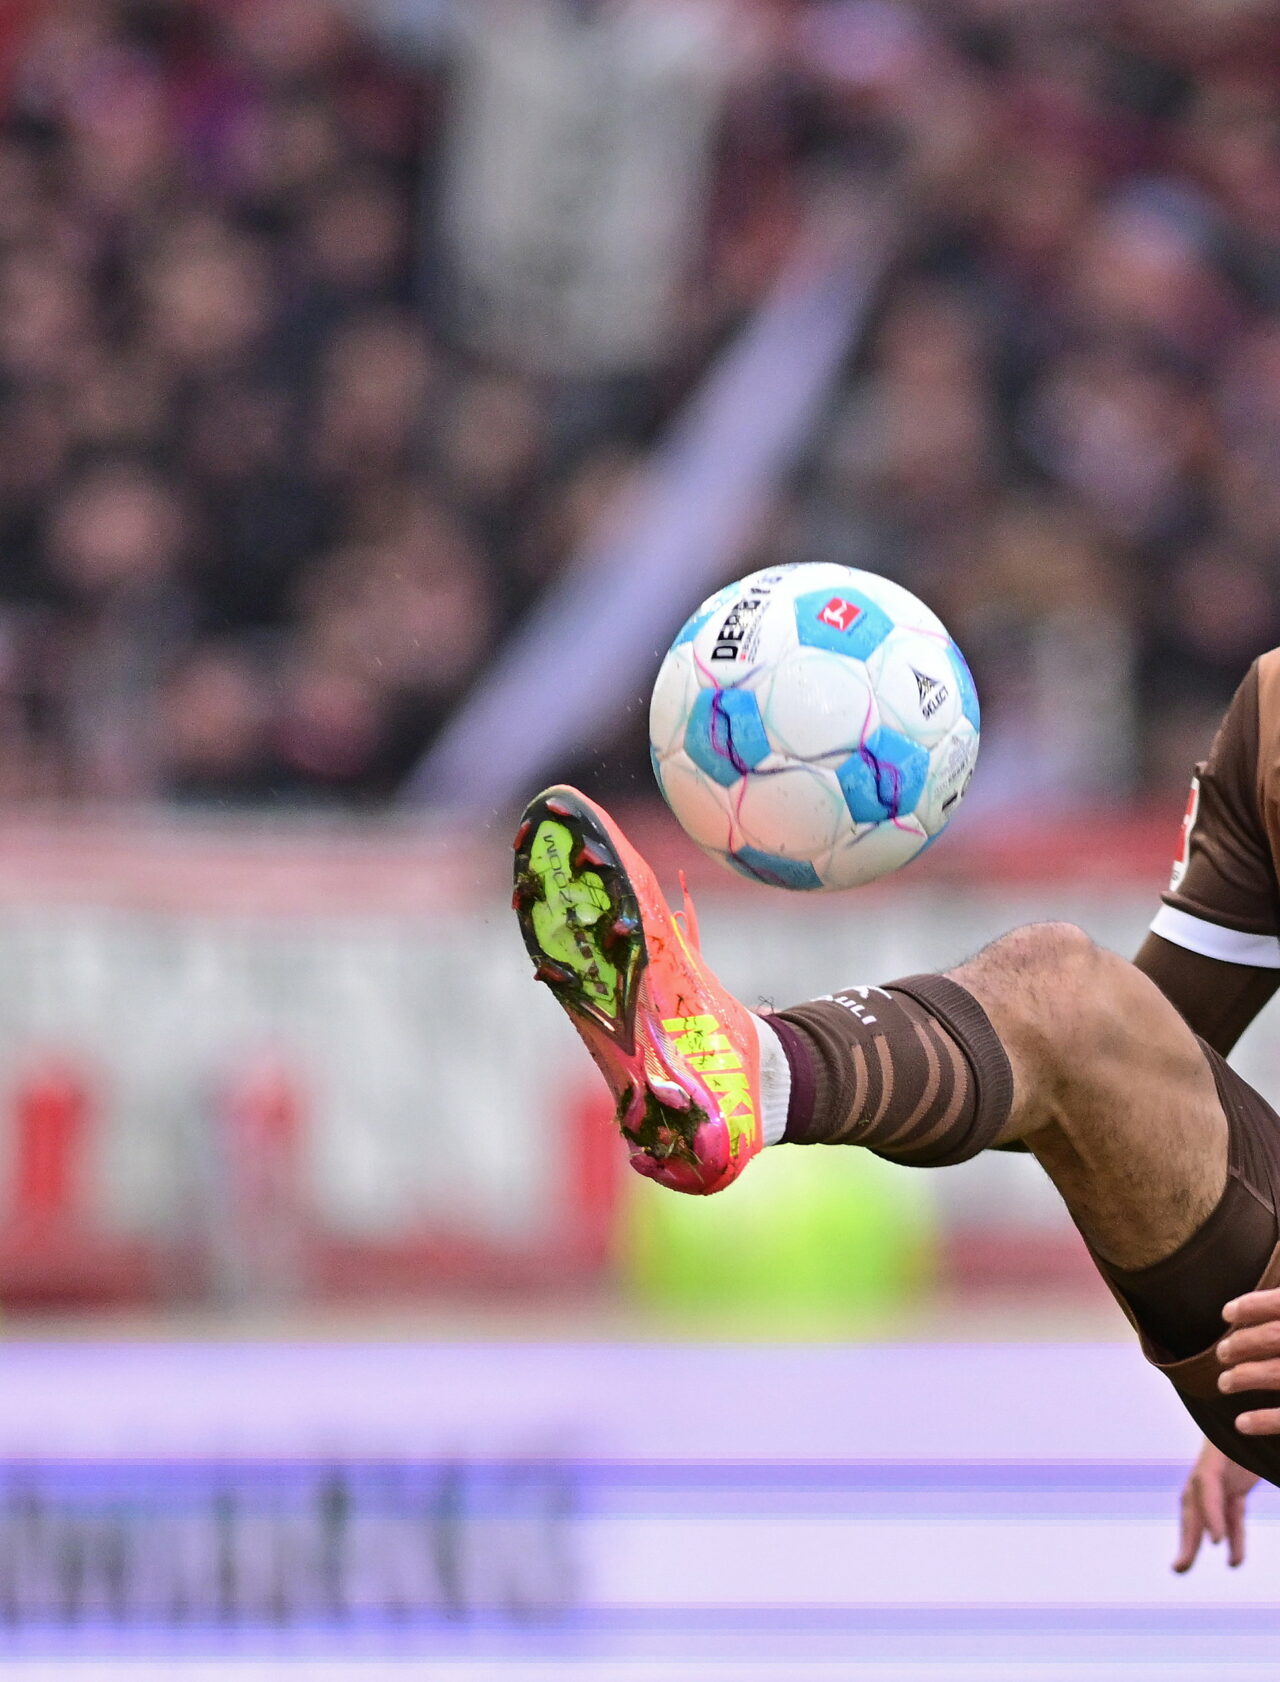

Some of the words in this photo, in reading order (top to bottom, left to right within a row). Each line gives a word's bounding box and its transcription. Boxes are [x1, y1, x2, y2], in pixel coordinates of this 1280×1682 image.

[922, 683, 949, 722] SELECT
[543, 833, 573, 903] ZOOM
[661, 1013, 756, 1158] NIKE
